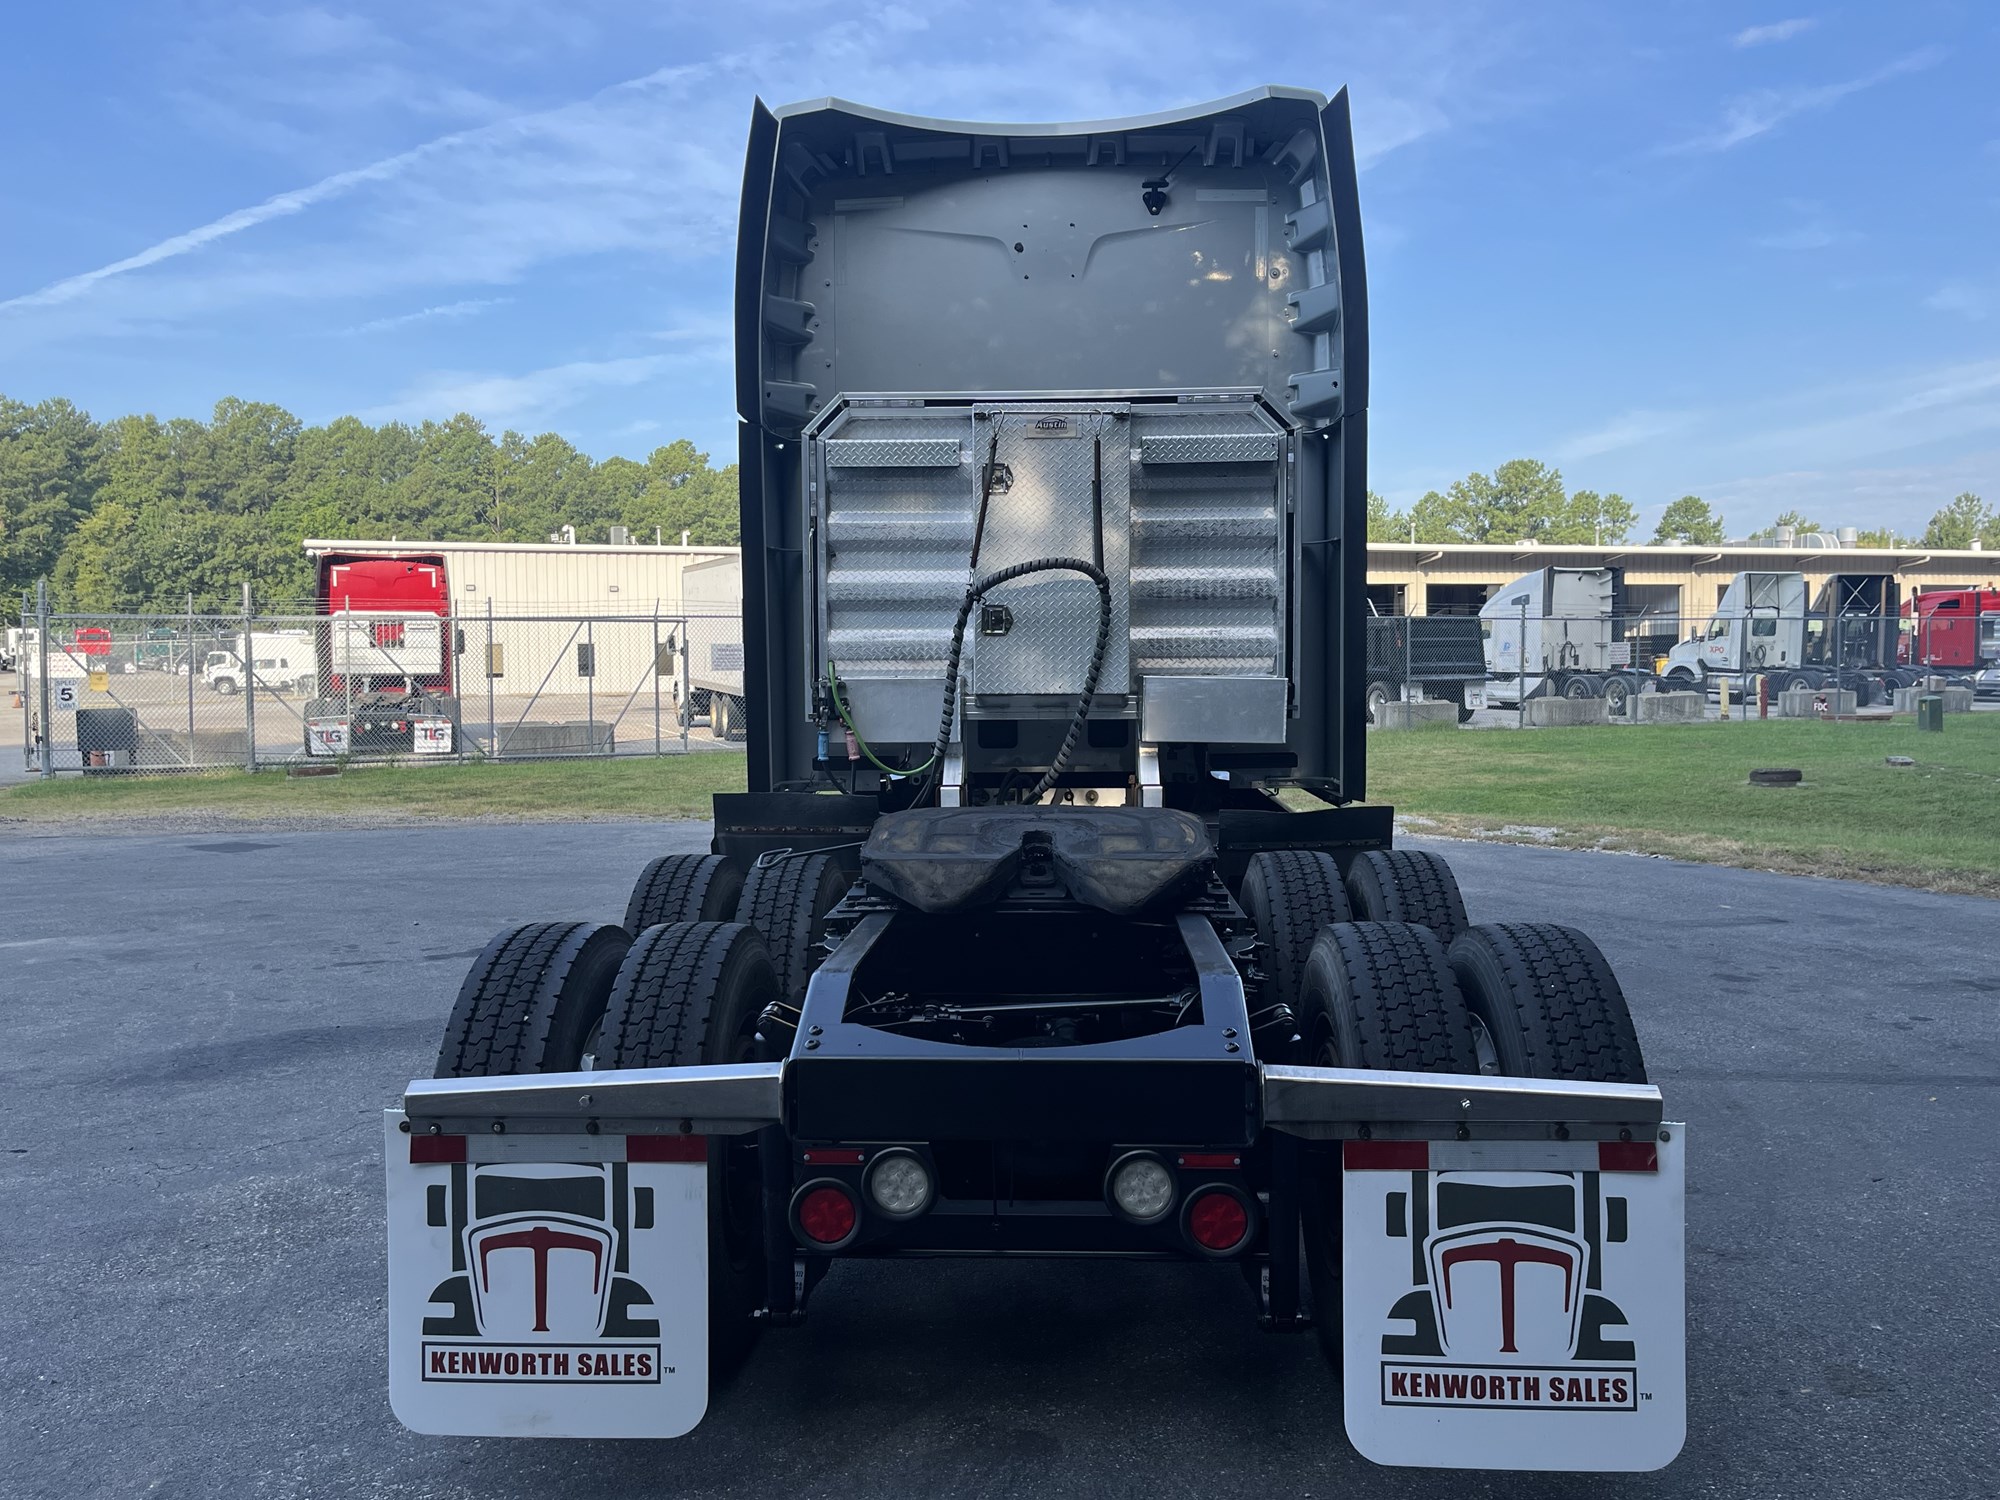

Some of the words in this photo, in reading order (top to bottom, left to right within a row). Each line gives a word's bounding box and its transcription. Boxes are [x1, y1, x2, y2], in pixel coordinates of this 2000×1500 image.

[1035, 421, 1068, 429] Austin
[60, 688, 73, 701] 5
[1813, 702, 1828, 711] FDC
[316, 730, 342, 743] TLG
[420, 728, 444, 741] TLG
[430, 1350, 570, 1377] KENWORTH
[577, 1352, 653, 1377] SALES
[1391, 1371, 1540, 1401] KENWORTH
[1549, 1376, 1628, 1403] SALES
